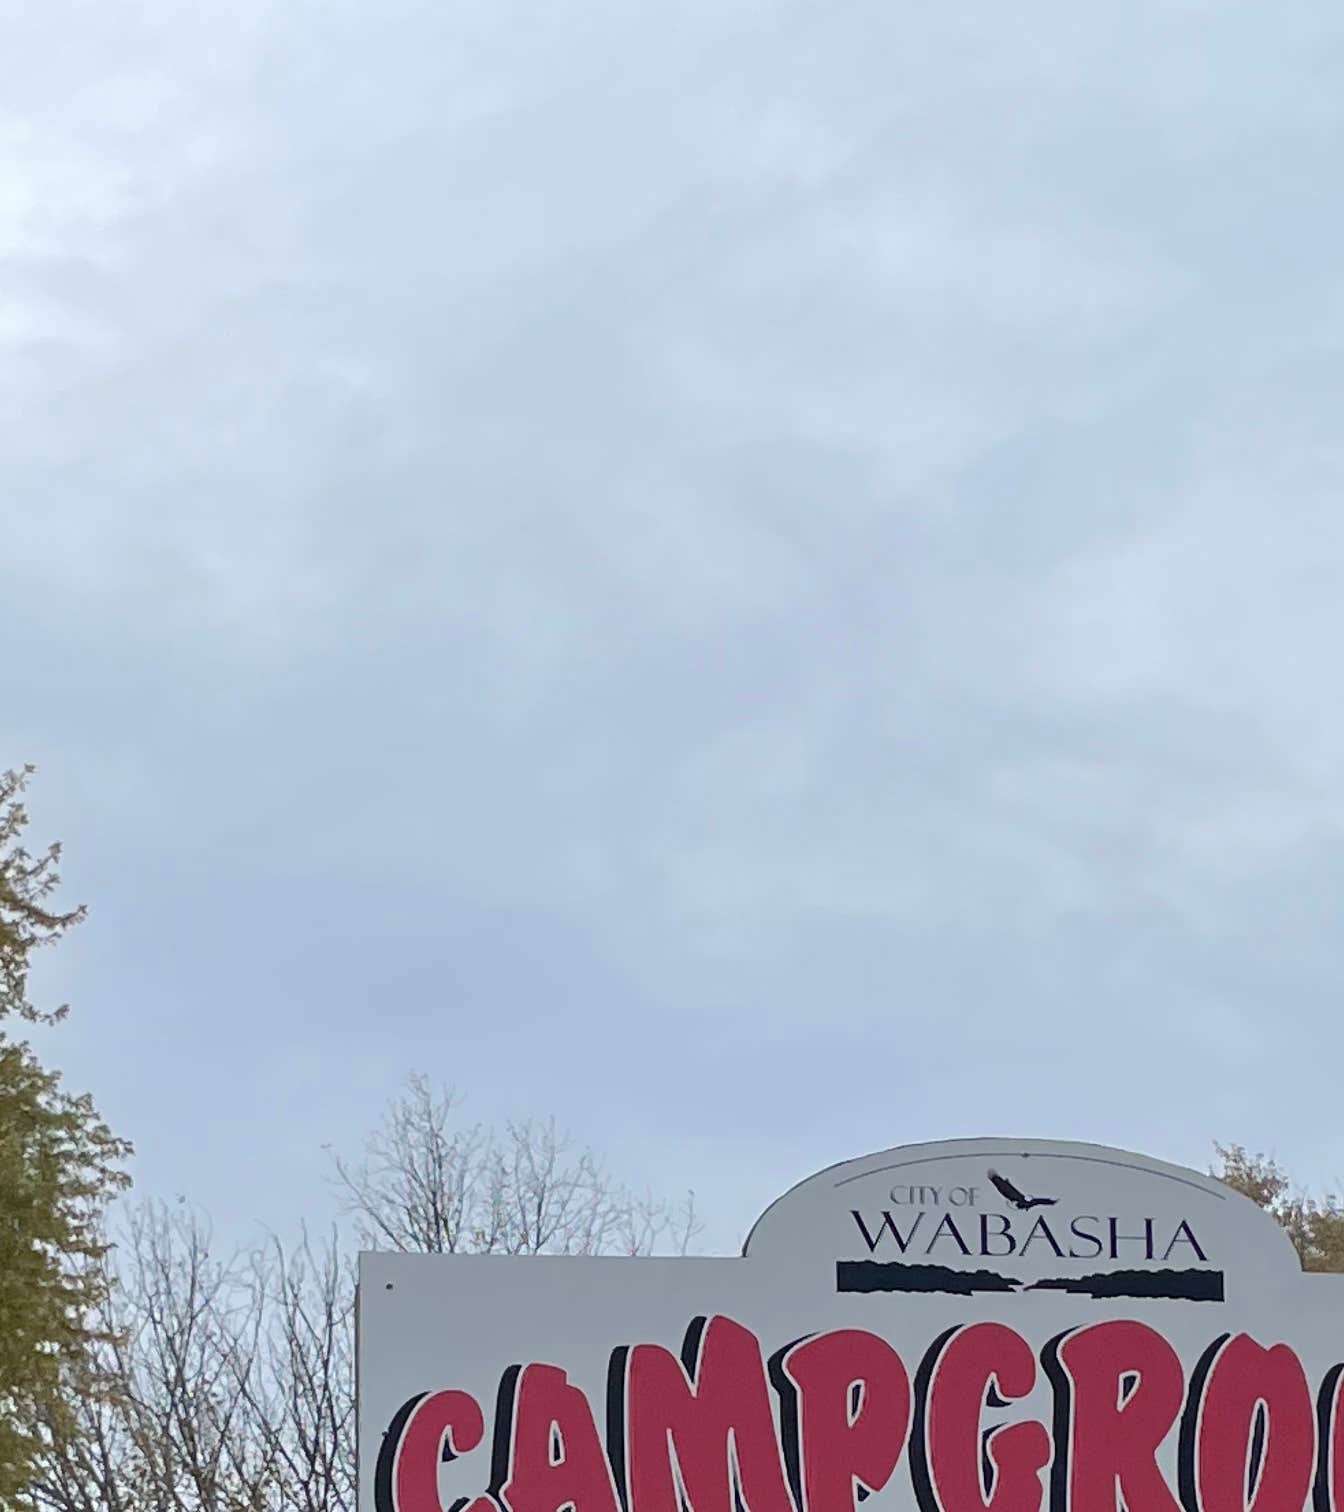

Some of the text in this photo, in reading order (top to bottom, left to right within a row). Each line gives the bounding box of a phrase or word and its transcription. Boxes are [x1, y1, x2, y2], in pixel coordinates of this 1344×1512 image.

[889, 1184, 981, 1207] CITY OF
[850, 1210, 1211, 1262] WABASHA
